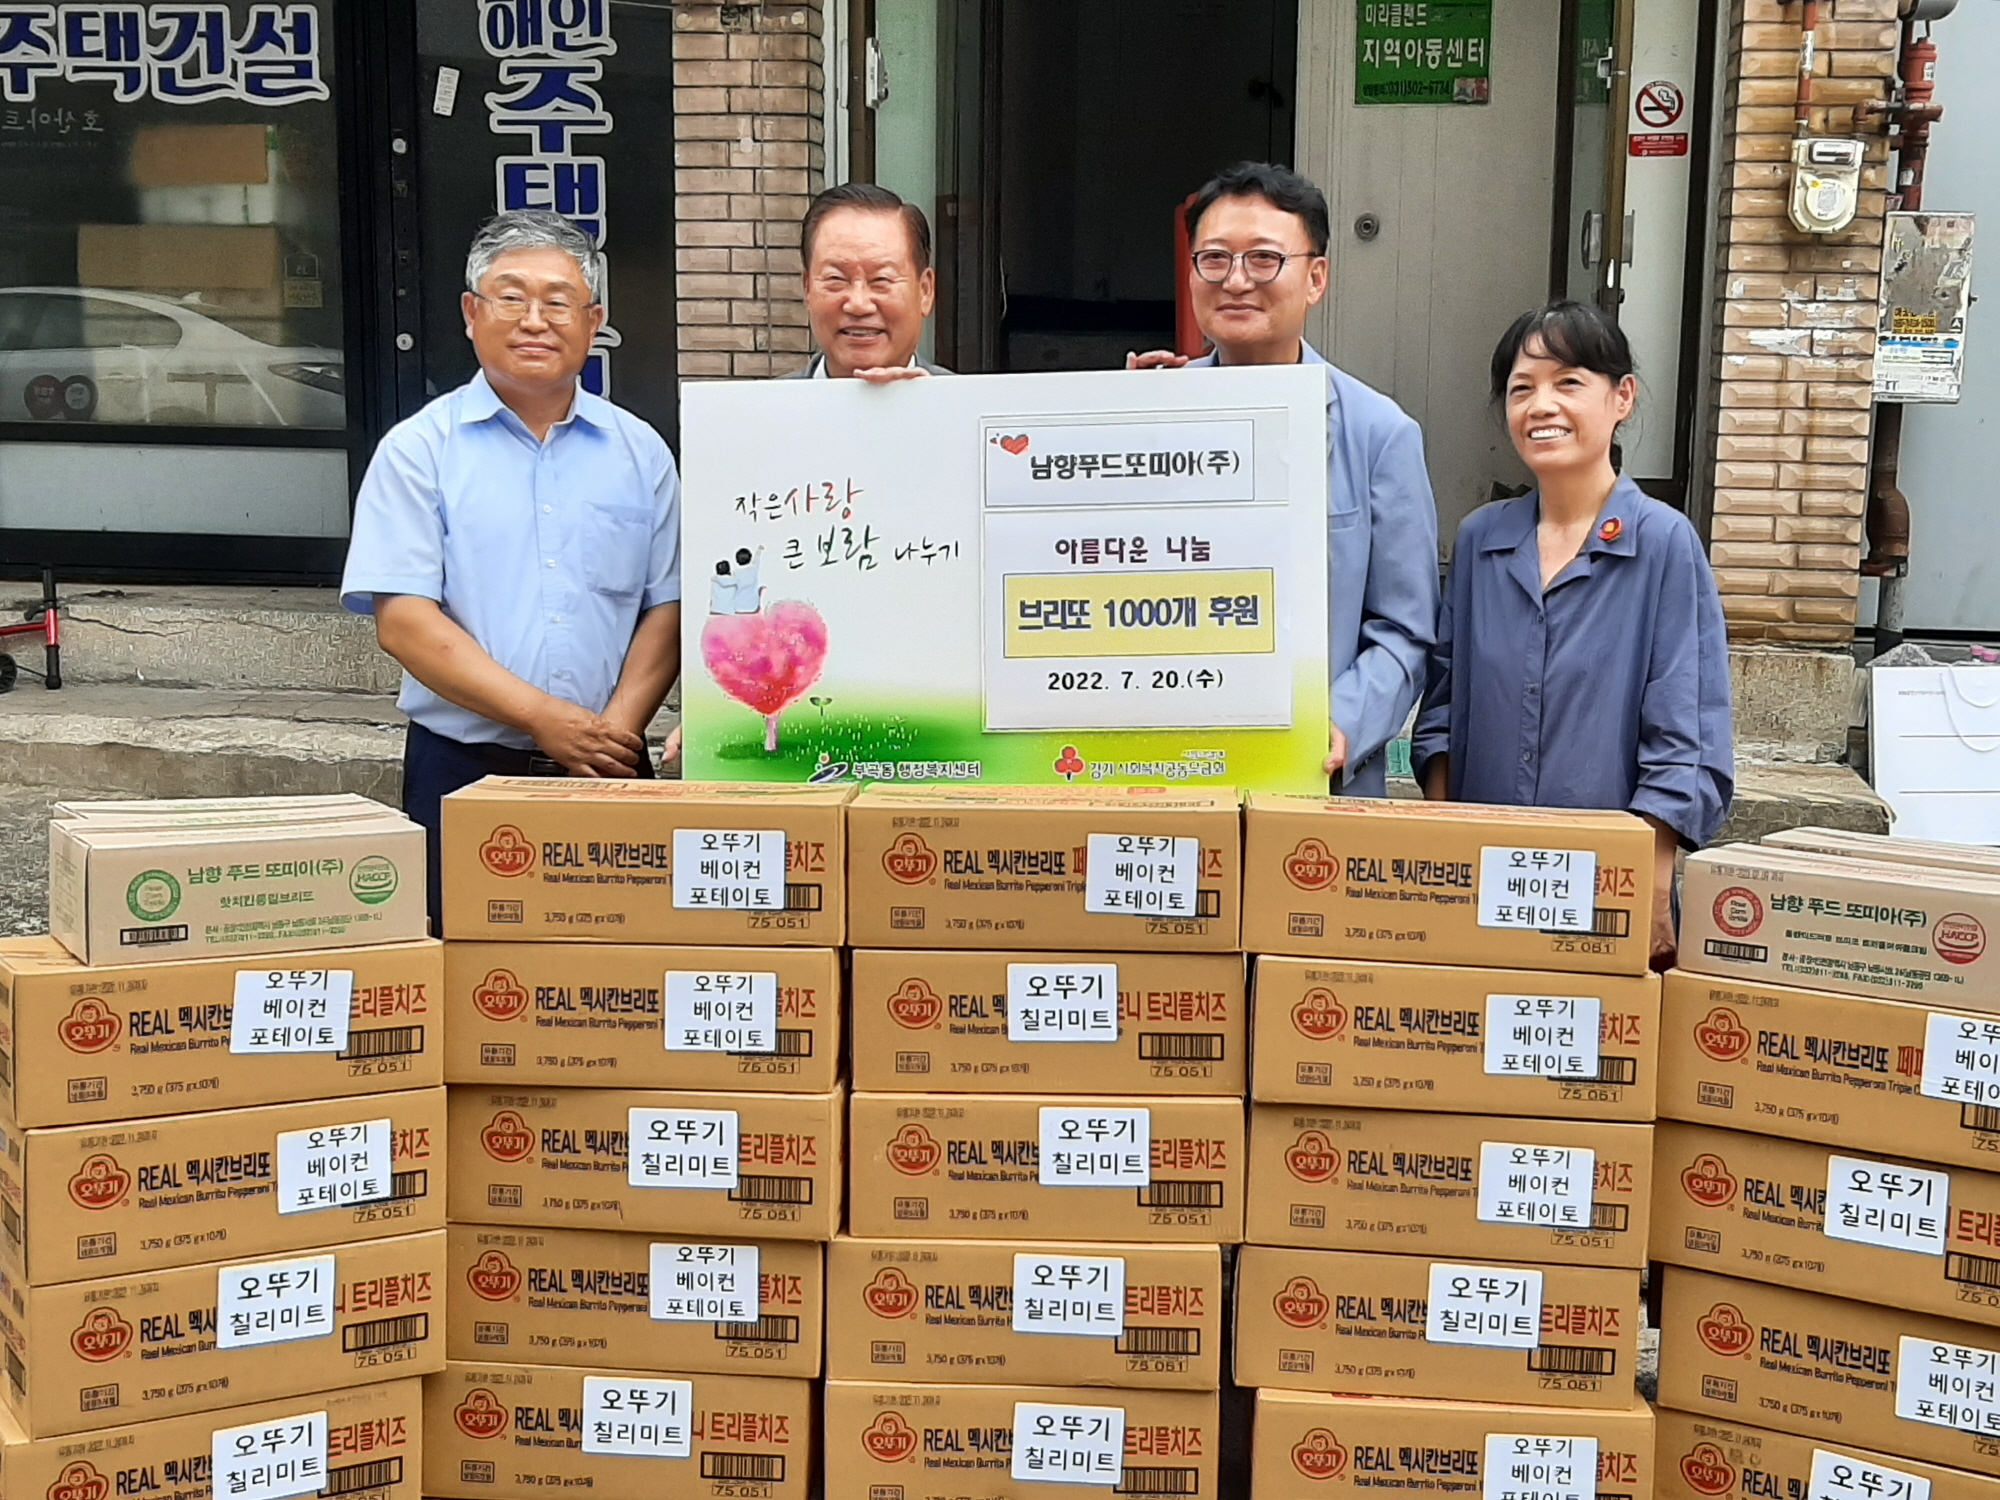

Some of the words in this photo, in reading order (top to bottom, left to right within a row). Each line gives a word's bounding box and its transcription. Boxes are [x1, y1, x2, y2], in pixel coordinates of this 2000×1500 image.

[478, 0, 617, 56] 해인
[0, 5, 329, 103] 주택건설
[1363, 38, 1484, 69] 지역아동센터
[1031, 451, 1239, 480] 남향푸드또띠아(주)
[783, 539, 803, 569] 큰
[818, 525, 879, 570] 보람
[895, 537, 958, 565] 나누기
[1055, 537, 1148, 564] 아름다운
[1167, 536, 1210, 562] 나눔
[1019, 600, 1091, 630] 브리또
[1104, 597, 1196, 627] 1000개
[1209, 595, 1258, 626] 후원
[1048, 672, 1108, 690] 2022.
[1122, 672, 1139, 689] 7.
[1152, 669, 1222, 688] 20.(수)
[853, 762, 893, 778] 부곡동
[899, 761, 980, 777] 행정복지센터
[542, 842, 584, 867] REAL
[700, 833, 760, 853] 오뚜기
[1116, 836, 1176, 857] 오뚜기
[188, 866, 222, 884] 남향
[227, 864, 261, 881] 푸드
[701, 860, 760, 880] 베이컨
[943, 850, 984, 874] REAL
[1116, 862, 1174, 884] 베이컨
[1346, 857, 1388, 883] REAL
[1509, 851, 1570, 872] 오뚜기
[689, 887, 771, 907] 포테이토
[1104, 890, 1185, 911] 포테이토
[1508, 877, 1569, 899] 베이컨
[1495, 905, 1578, 927] 포테이토
[1770, 894, 1803, 913] 남향
[1808, 898, 1842, 917] 푸드
[1847, 902, 1927, 928] 또띠아(주)
[265, 970, 329, 991] 오뚜기
[694, 975, 752, 995] 오뚜기
[1026, 974, 1102, 1000] 오뚜기
[264, 999, 326, 1019] 베이컨
[535, 986, 577, 1011] REAL
[694, 1001, 753, 1021] 베이컨
[949, 995, 989, 1018] REAL
[1514, 999, 1574, 1019] 오뚜기
[129, 1009, 175, 1037] REAL
[1020, 1008, 1112, 1031] 칠리미트
[1354, 1006, 1395, 1032] REAL
[249, 1026, 334, 1047] 포테이토
[683, 1029, 764, 1049] 포테이토
[1513, 1025, 1573, 1047] 베이컨
[1757, 1030, 1800, 1060] REAL
[1501, 1054, 1584, 1074] 포테이토
[307, 1124, 367, 1149] 오뚜기
[541, 1128, 581, 1154] REAL
[648, 1120, 723, 1146] 오뚜기
[1058, 1119, 1135, 1143] 오뚜기
[308, 1151, 368, 1177] 베이컨
[947, 1140, 988, 1165] REAL
[1052, 1152, 1144, 1175] 칠리미트
[1347, 1150, 1388, 1176] REAL
[1509, 1148, 1570, 1169] 오뚜기
[138, 1163, 183, 1192] REAL
[642, 1153, 731, 1178] 칠리미트
[297, 1179, 379, 1206] 포테이토
[1508, 1174, 1569, 1196] 베이컨
[1744, 1178, 1785, 1208] REAL
[1848, 1170, 1932, 1206] 오뚜기
[1496, 1201, 1578, 1223] 포테이토
[1839, 1203, 1938, 1239] 칠리미트
[676, 1246, 734, 1266] 오뚜기
[237, 1268, 317, 1300] 오뚜기
[528, 1268, 568, 1293] REAL
[677, 1272, 734, 1292] 베이컨
[1031, 1265, 1108, 1292] 오뚜기
[925, 1285, 965, 1310] REAL
[1448, 1277, 1526, 1306] 오뚜기
[230, 1304, 325, 1336] 칠리미트
[666, 1298, 745, 1318] 포테이토
[1025, 1298, 1115, 1322] 칠리미트
[1336, 1295, 1377, 1321] REAL
[140, 1313, 185, 1343] REAL
[1441, 1309, 1533, 1336] 칠리미트
[1760, 1327, 1803, 1359] REAL
[1930, 1346, 1995, 1375] 오뚜기
[1929, 1373, 1994, 1403] 베이컨
[601, 1389, 675, 1416] 오뚜기
[515, 1406, 555, 1432] REAL
[1032, 1415, 1109, 1442] 오뚜기
[233, 1421, 312, 1457] 오뚜기
[594, 1421, 683, 1446] 칠리미트
[924, 1428, 965, 1452] REAL
[1025, 1447, 1115, 1473] 칠리미트
[1354, 1446, 1395, 1471] REAL
[1512, 1438, 1572, 1458] 오뚜기
[116, 1466, 160, 1496] REAL
[226, 1457, 321, 1494] 칠리미트
[1512, 1464, 1571, 1485] 베이컨
[1828, 1465, 1912, 1500] 오뚜기
